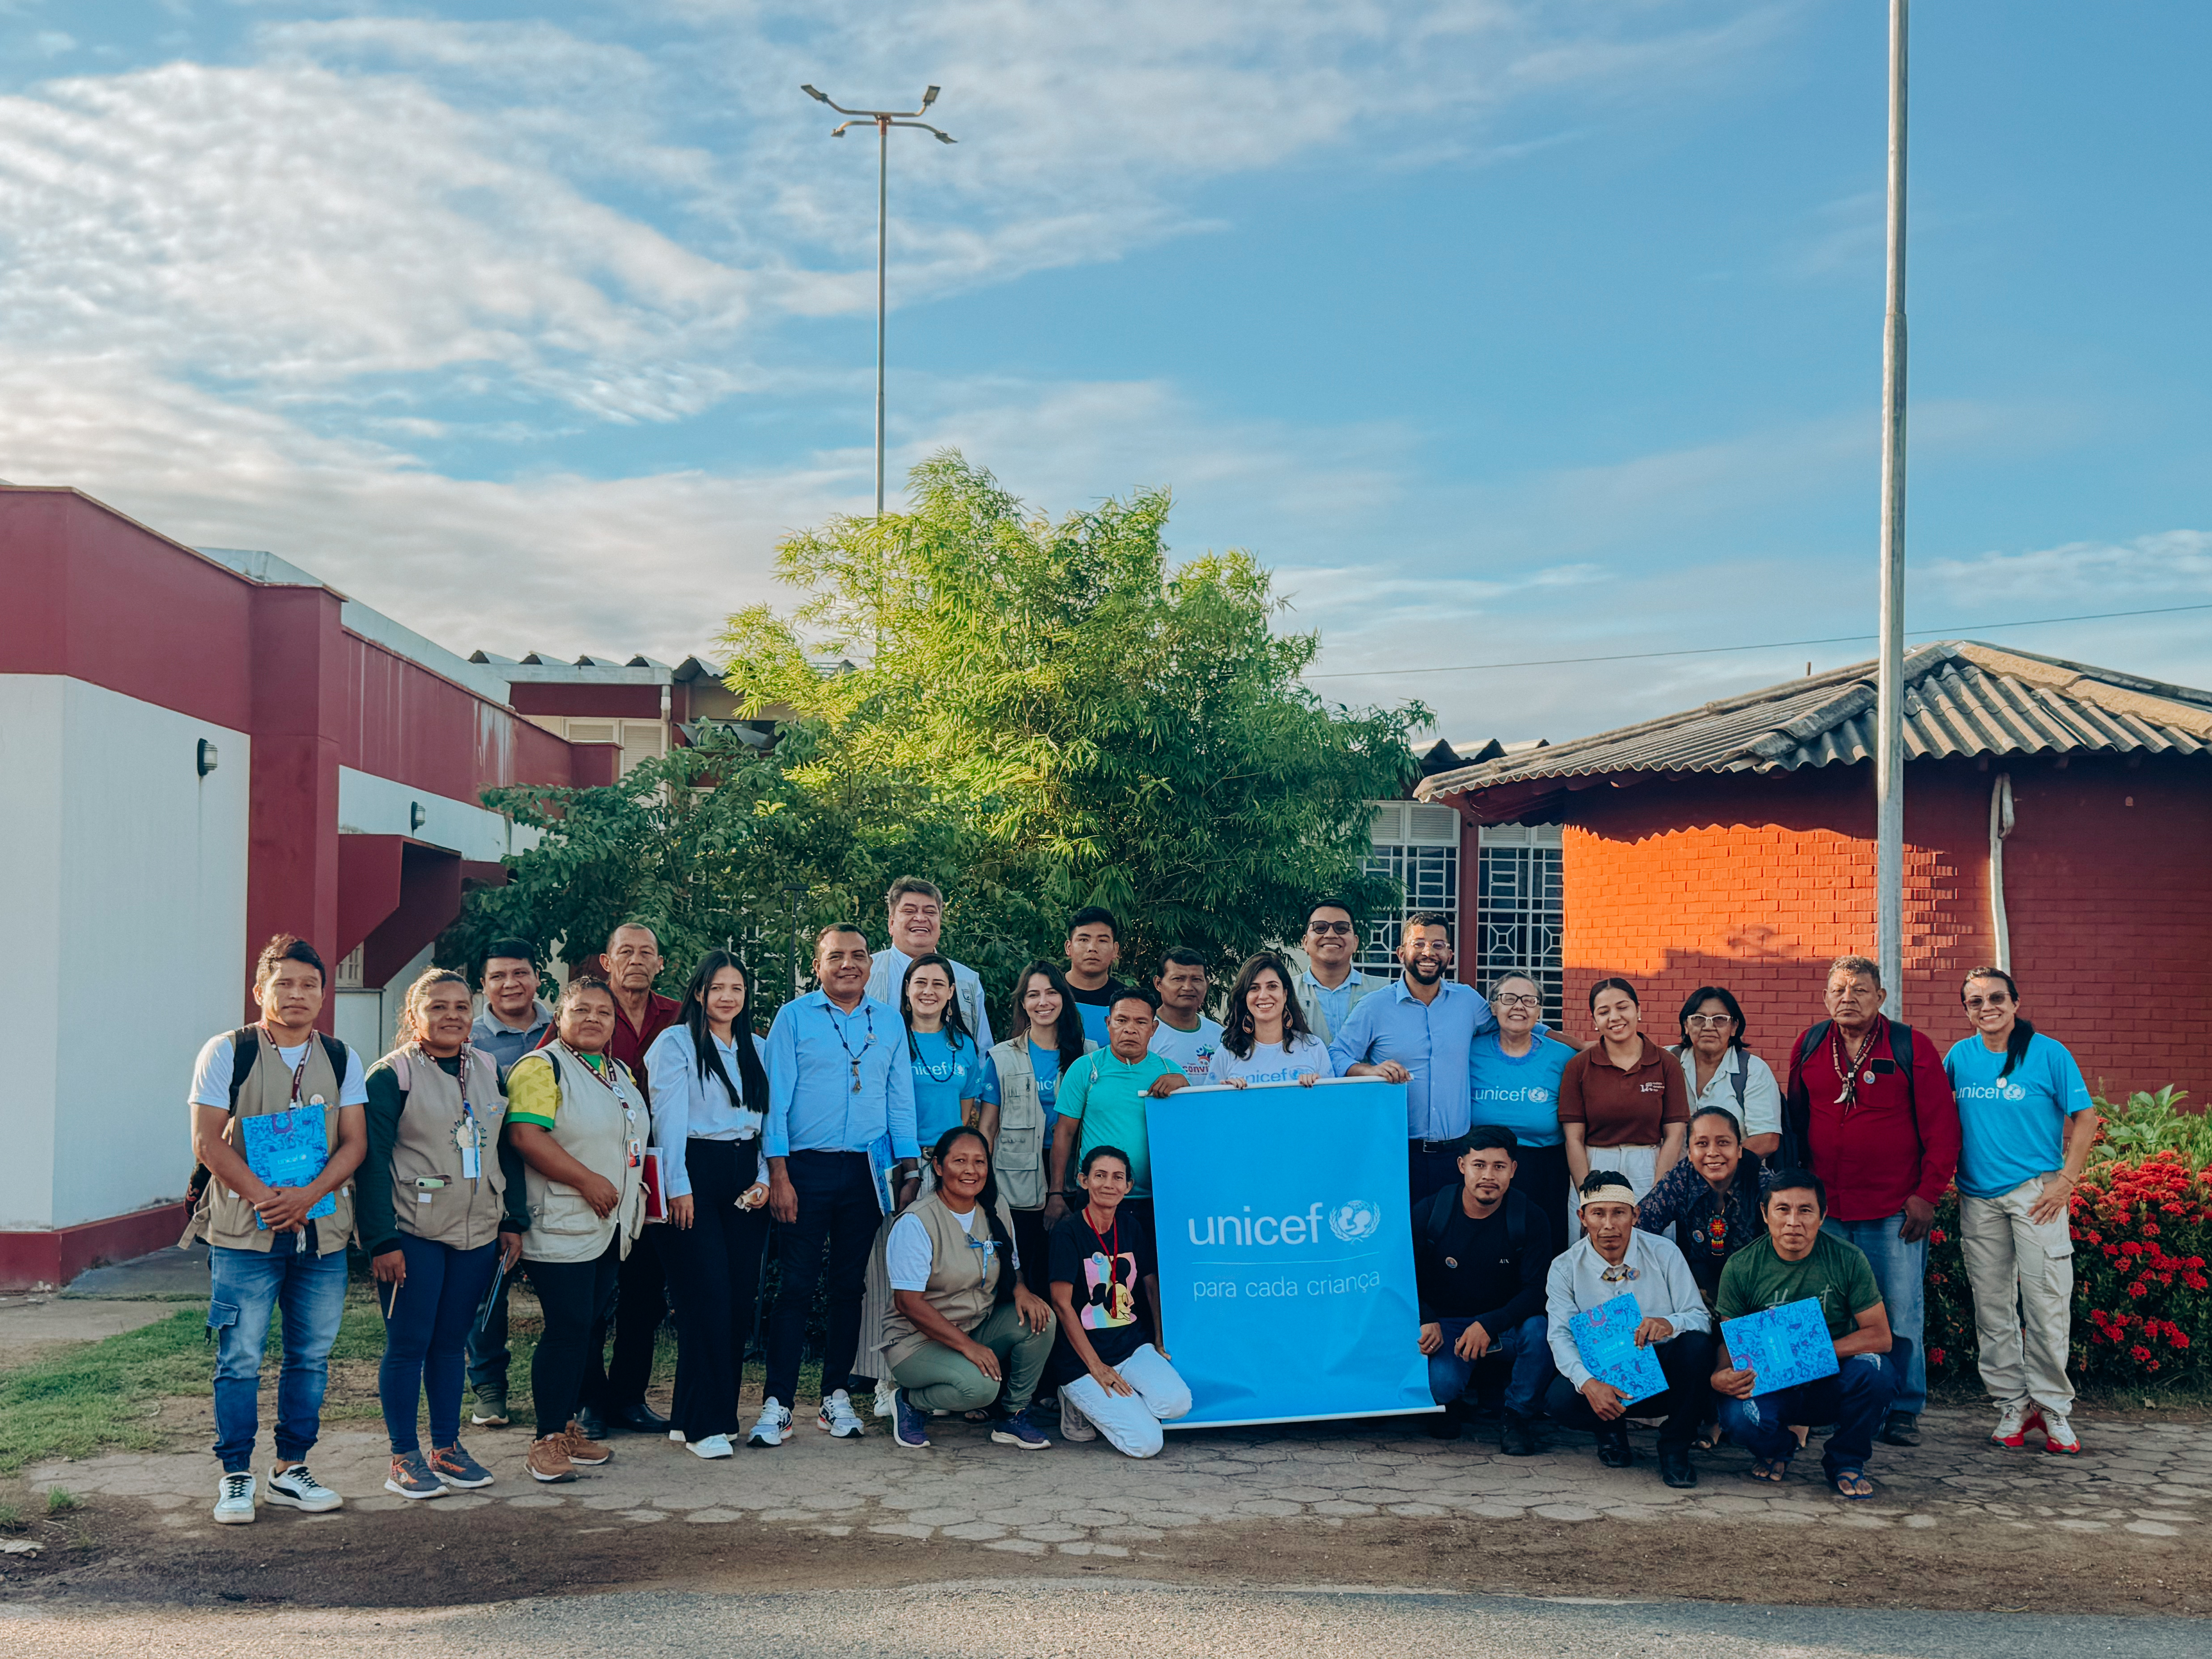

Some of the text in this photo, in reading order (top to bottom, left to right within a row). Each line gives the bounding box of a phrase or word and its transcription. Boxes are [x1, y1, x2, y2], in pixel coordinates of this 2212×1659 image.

[911, 1061, 947, 1075] nicef
[1236, 1068, 1287, 1083] nicef
[1475, 1086, 1527, 1102] unicef
[1188, 1202, 1323, 1245] unicef
[1193, 1271, 1380, 1302] para cada criança
